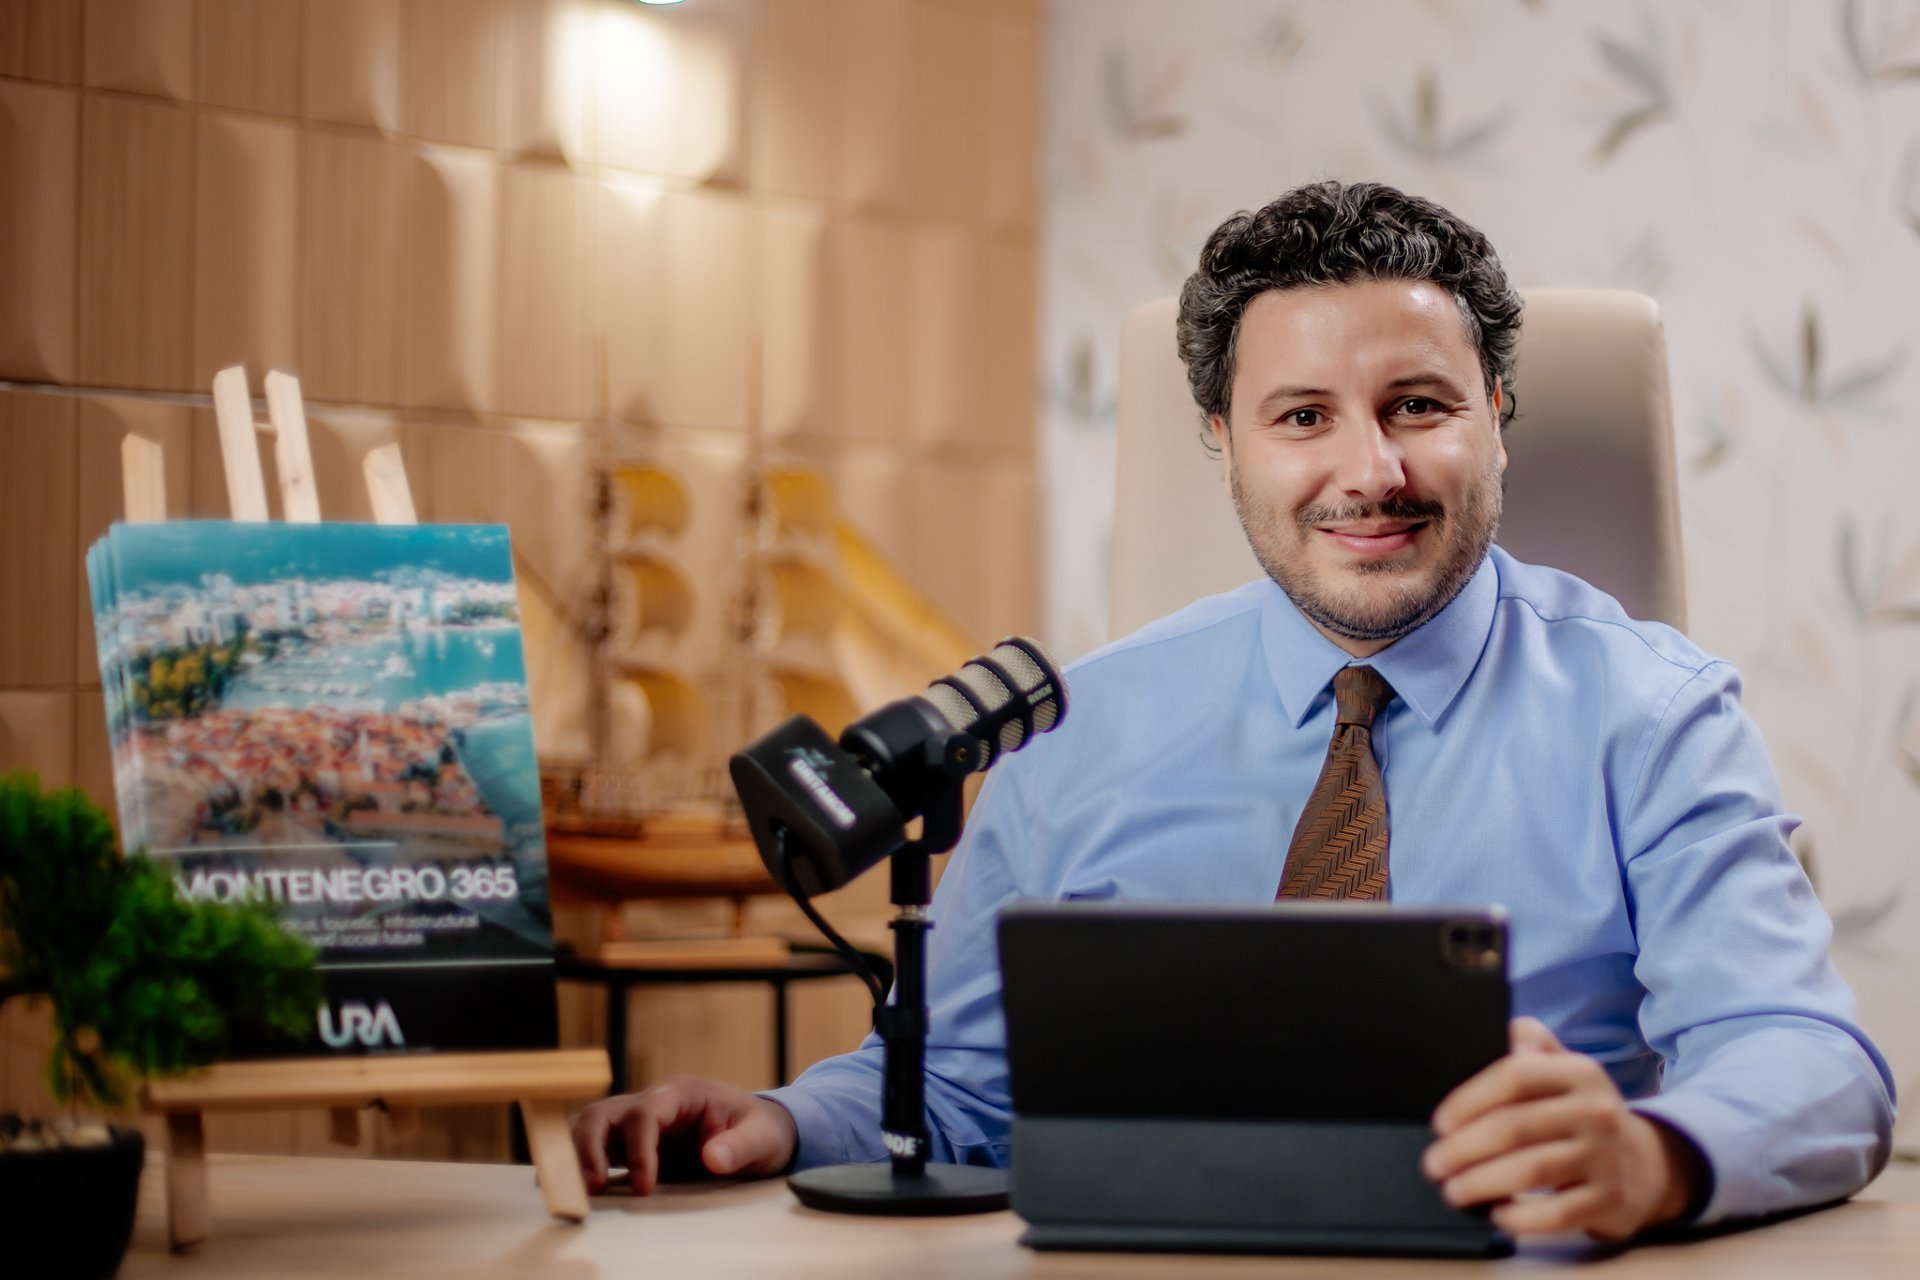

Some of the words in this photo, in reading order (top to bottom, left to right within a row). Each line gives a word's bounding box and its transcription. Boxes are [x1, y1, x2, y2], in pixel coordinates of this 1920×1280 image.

[173, 868, 445, 902] MONTENEGRO
[450, 867, 517, 899] 365
[318, 1002, 404, 1047] URA
